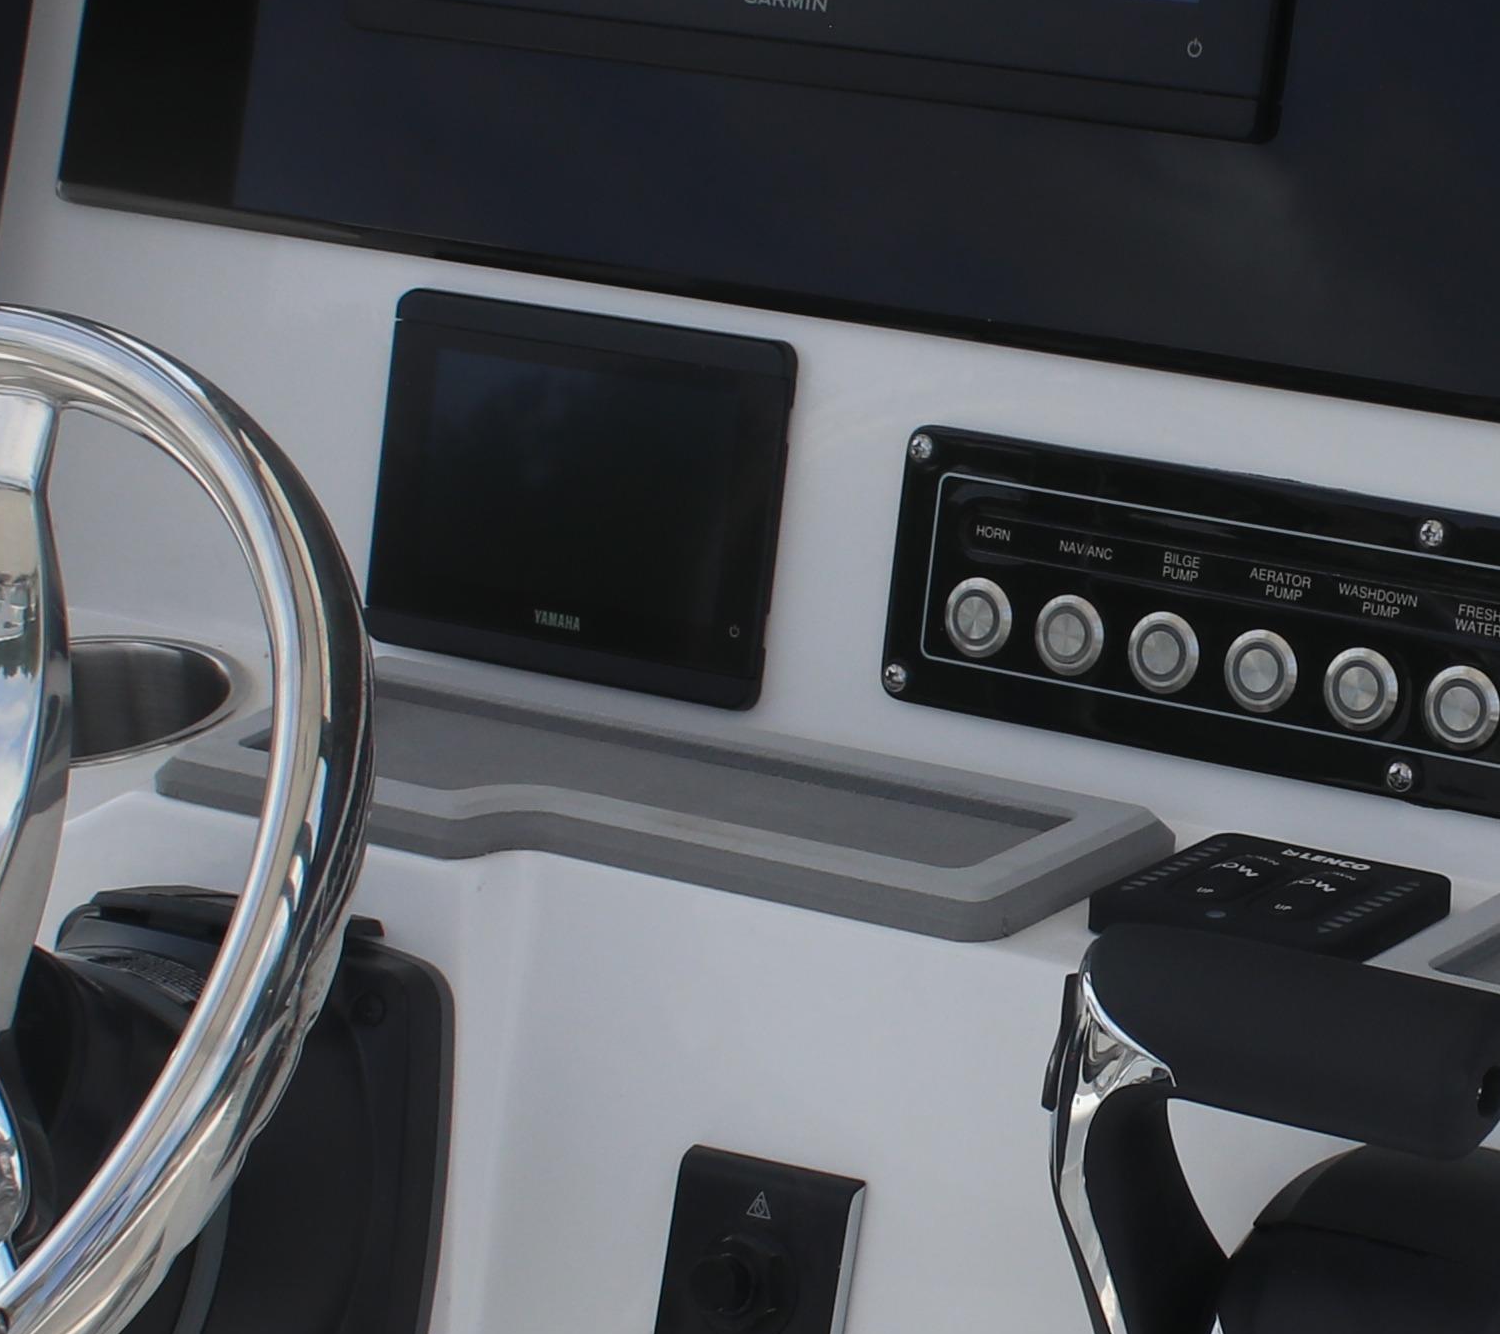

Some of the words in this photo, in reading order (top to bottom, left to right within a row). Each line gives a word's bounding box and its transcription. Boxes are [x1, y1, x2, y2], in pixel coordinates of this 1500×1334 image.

[976, 524, 1011, 542] HORN
[1059, 539, 1113, 561] NAV/ANC
[1163, 551, 1201, 570] BILGE
[1162, 565, 1200, 582] PUMP
[1249, 567, 1312, 591] AERATOR
[1265, 585, 1305, 601] PUMP
[1338, 582, 1418, 609] WASHDOWN
[1362, 600, 1401, 618] PUMP
[534, 609, 580, 632] YAMAHA
[1297, 850, 1373, 871] LENCO
